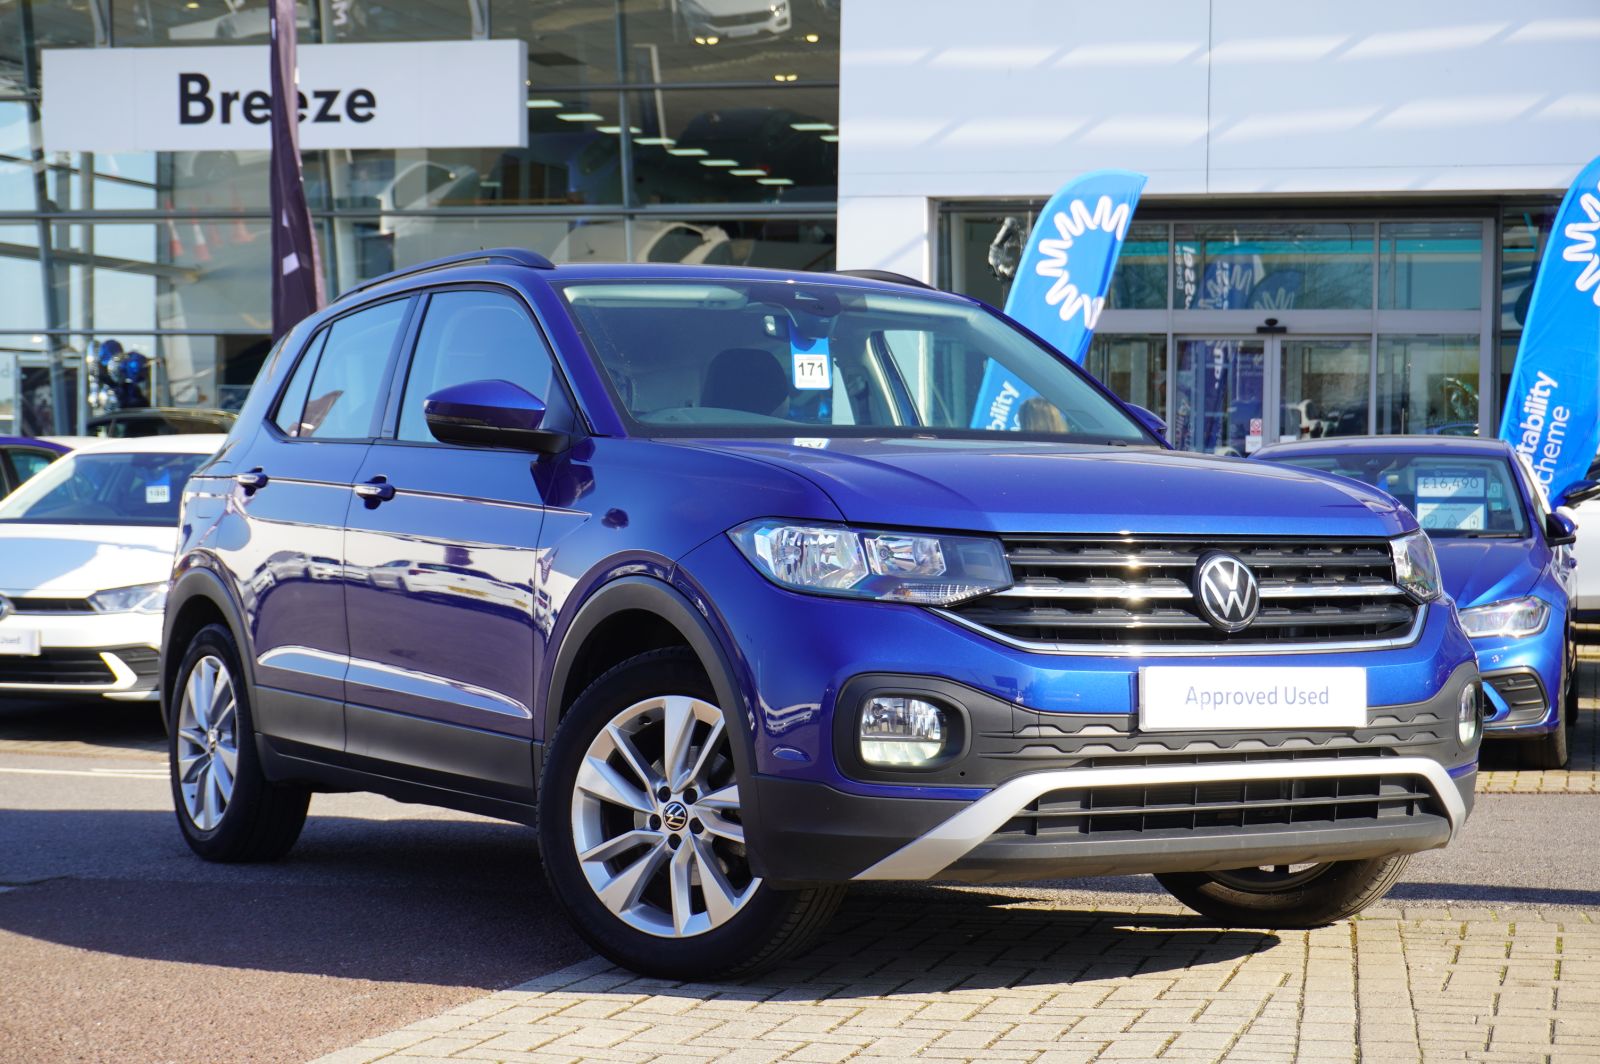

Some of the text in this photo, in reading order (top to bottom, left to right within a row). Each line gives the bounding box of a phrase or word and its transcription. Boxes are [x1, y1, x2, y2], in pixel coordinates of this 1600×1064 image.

[798, 361, 825, 377] 171
[1422, 477, 1479, 491] £16,490
[1185, 686, 1329, 710] Approved Used
